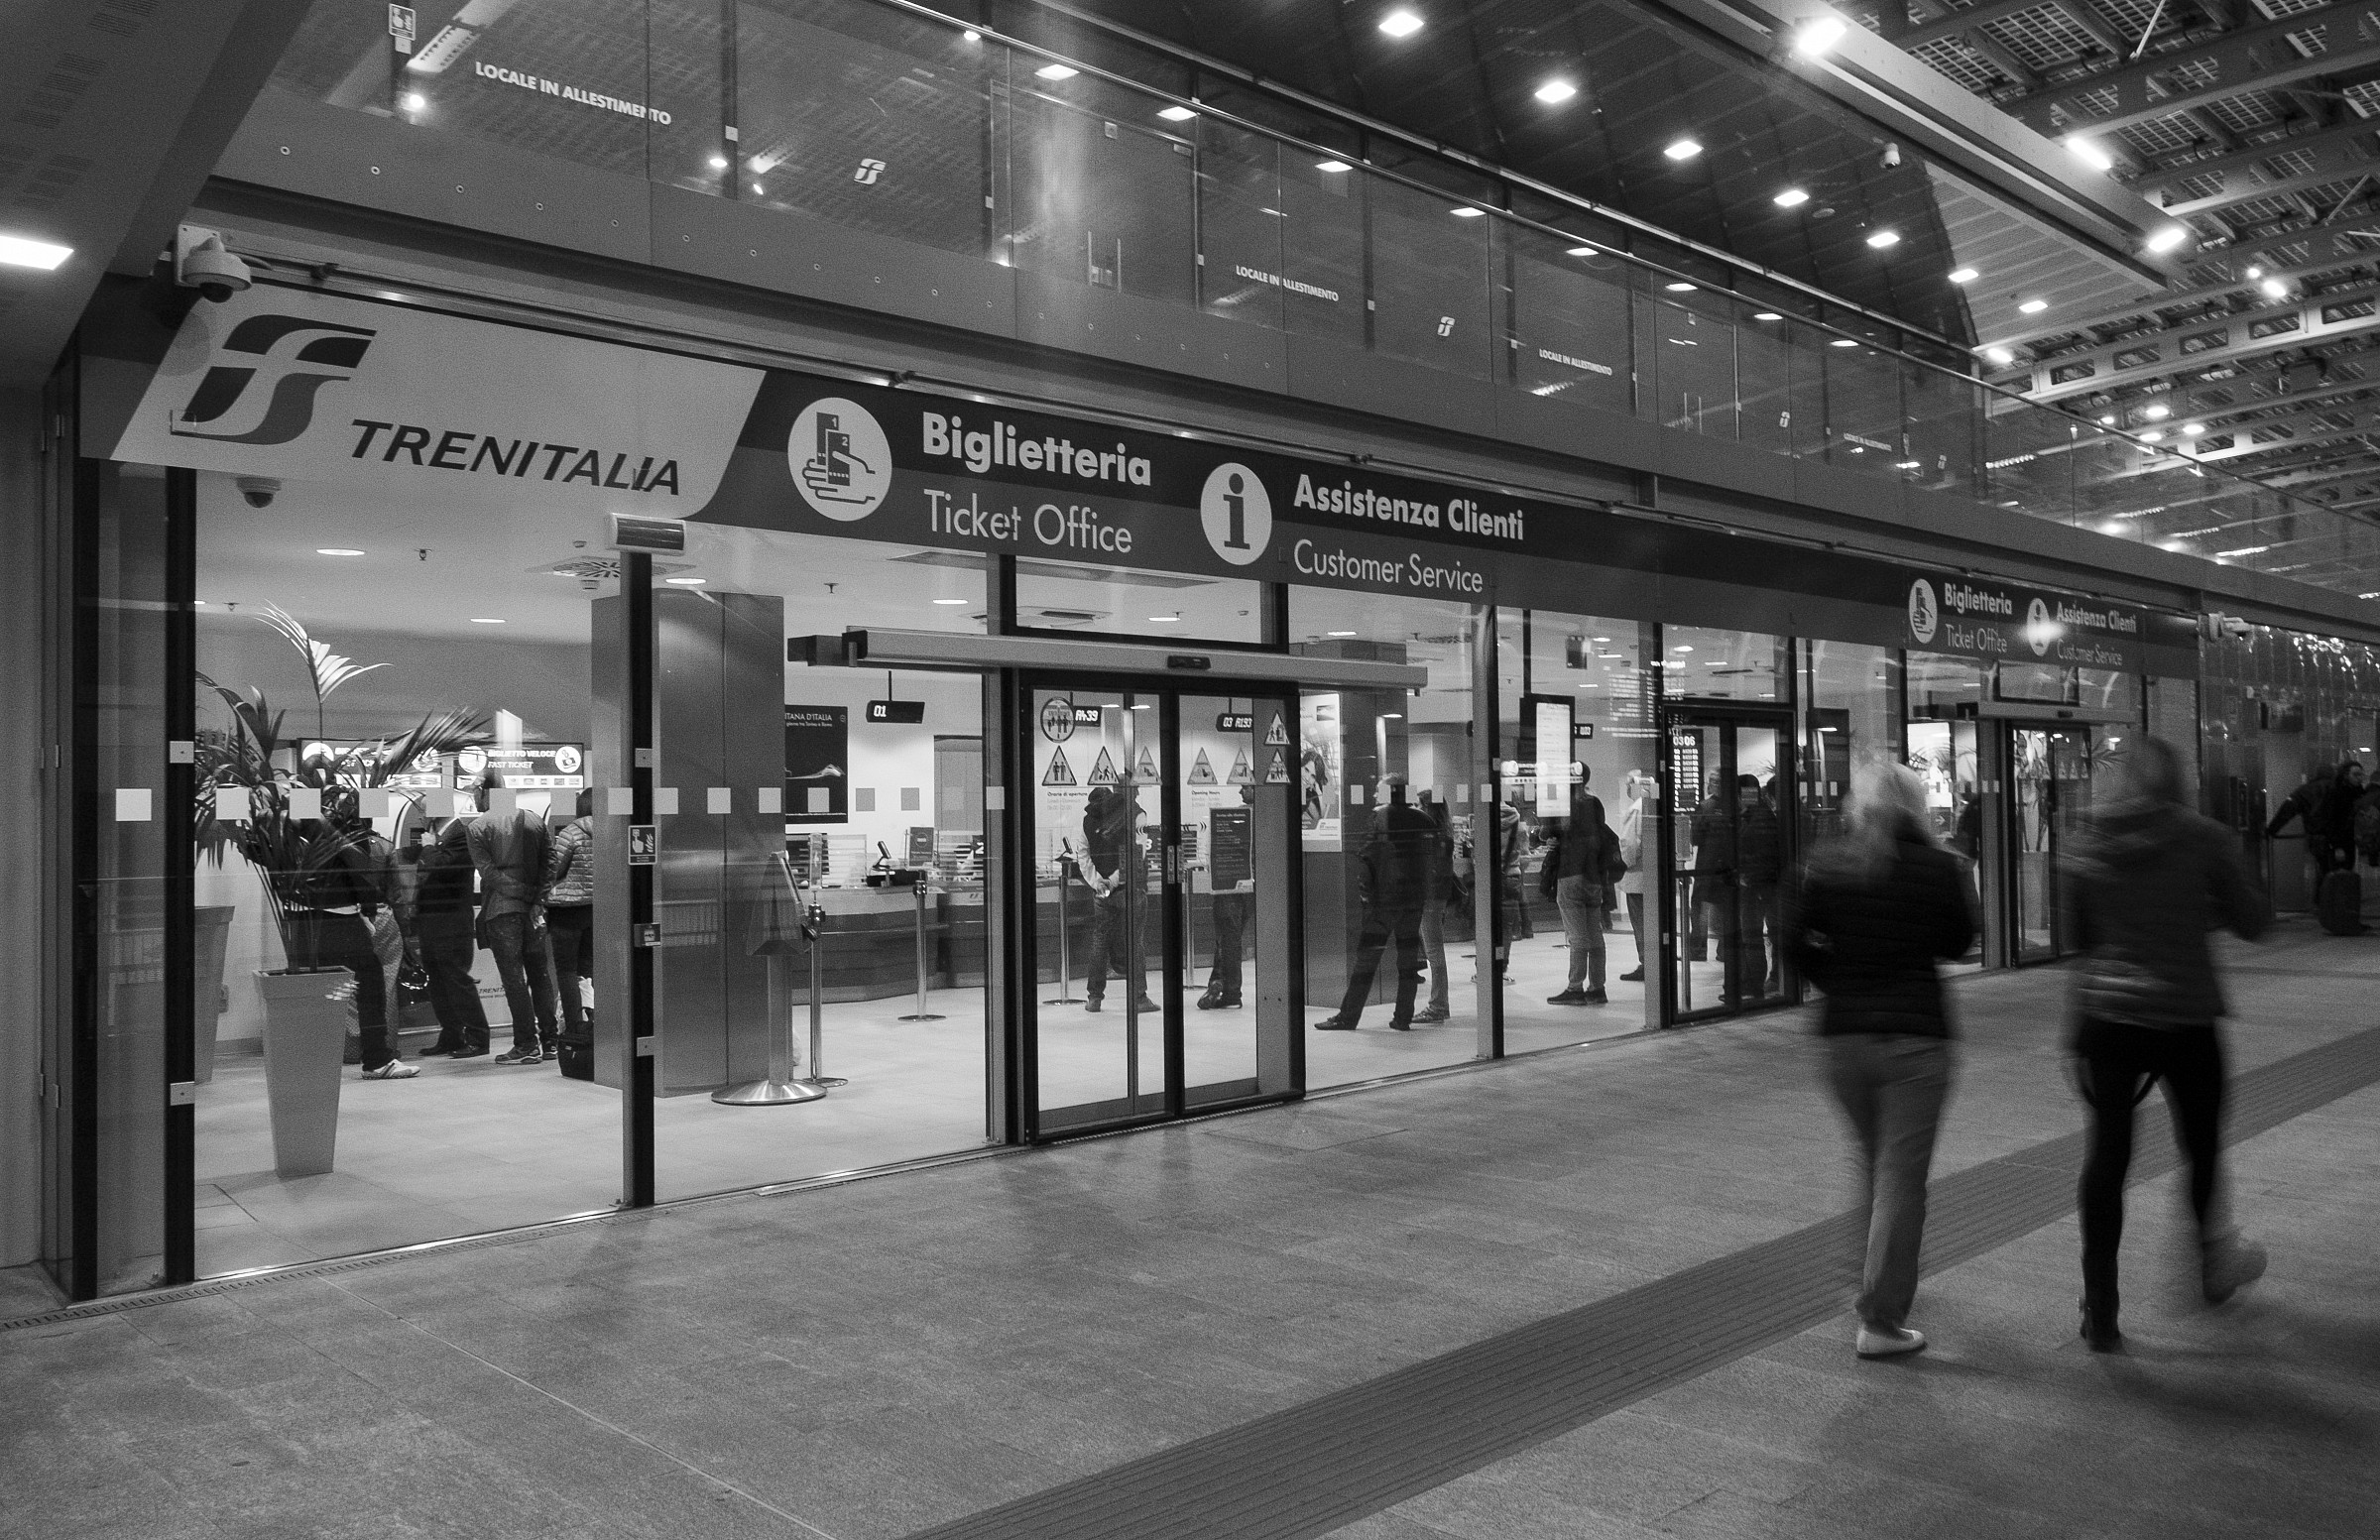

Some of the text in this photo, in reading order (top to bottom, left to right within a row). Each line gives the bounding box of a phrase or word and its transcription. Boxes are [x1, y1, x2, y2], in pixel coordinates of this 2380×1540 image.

[475, 61, 672, 125] LOCALE IN ALLESTIMENTO
[1236, 265, 1268, 284] LOCALE
[1269, 274, 1280, 287] IN
[1539, 348, 1563, 364] LOCALE
[351, 418, 679, 496] TRENITALIA
[923, 412, 1151, 486] Biglietteria
[923, 488, 1133, 553] Ticket Office
[1293, 473, 1524, 540] Assistenza Clienti
[1293, 538, 1484, 593] Customer Service
[1944, 582, 2013, 616] Biglietteria
[2056, 601, 2137, 634] Assistenza Clienti
[1945, 623, 2008, 653] Ticket Office
[873, 704, 888, 718] 01
[1223, 716, 1234, 728] 03
